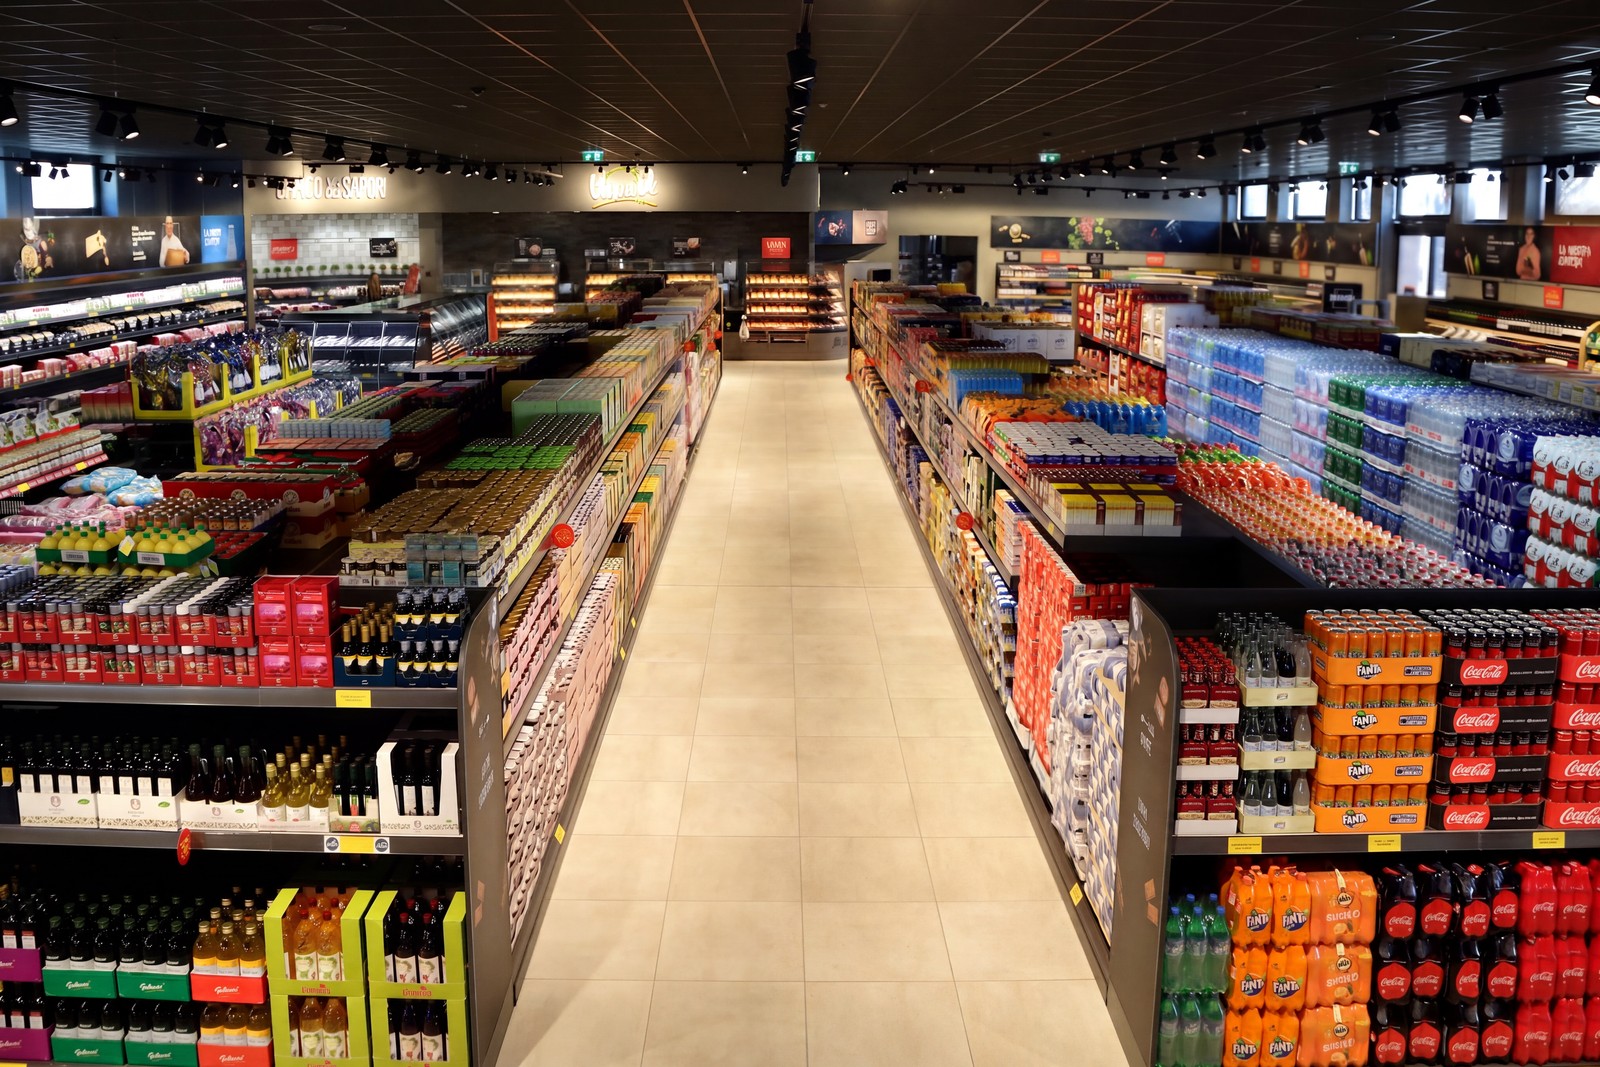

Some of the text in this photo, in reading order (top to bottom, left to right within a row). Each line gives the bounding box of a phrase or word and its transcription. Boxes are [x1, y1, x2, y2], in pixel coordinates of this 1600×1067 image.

[342, 176, 386, 199] SAPORI
[1357, 664, 1382, 676] FANTA
[1352, 714, 1377, 726] FANTA
[1347, 764, 1373, 777] FANTA
[1342, 814, 1367, 825] FANTA
[1246, 912, 1270, 926] FANTA
[1282, 911, 1307, 926] FANTA
[1241, 979, 1264, 993] FANTA
[1273, 979, 1300, 993] FANTA
[1233, 1042, 1256, 1056] FANTA
[1269, 1042, 1294, 1055] FANTA
